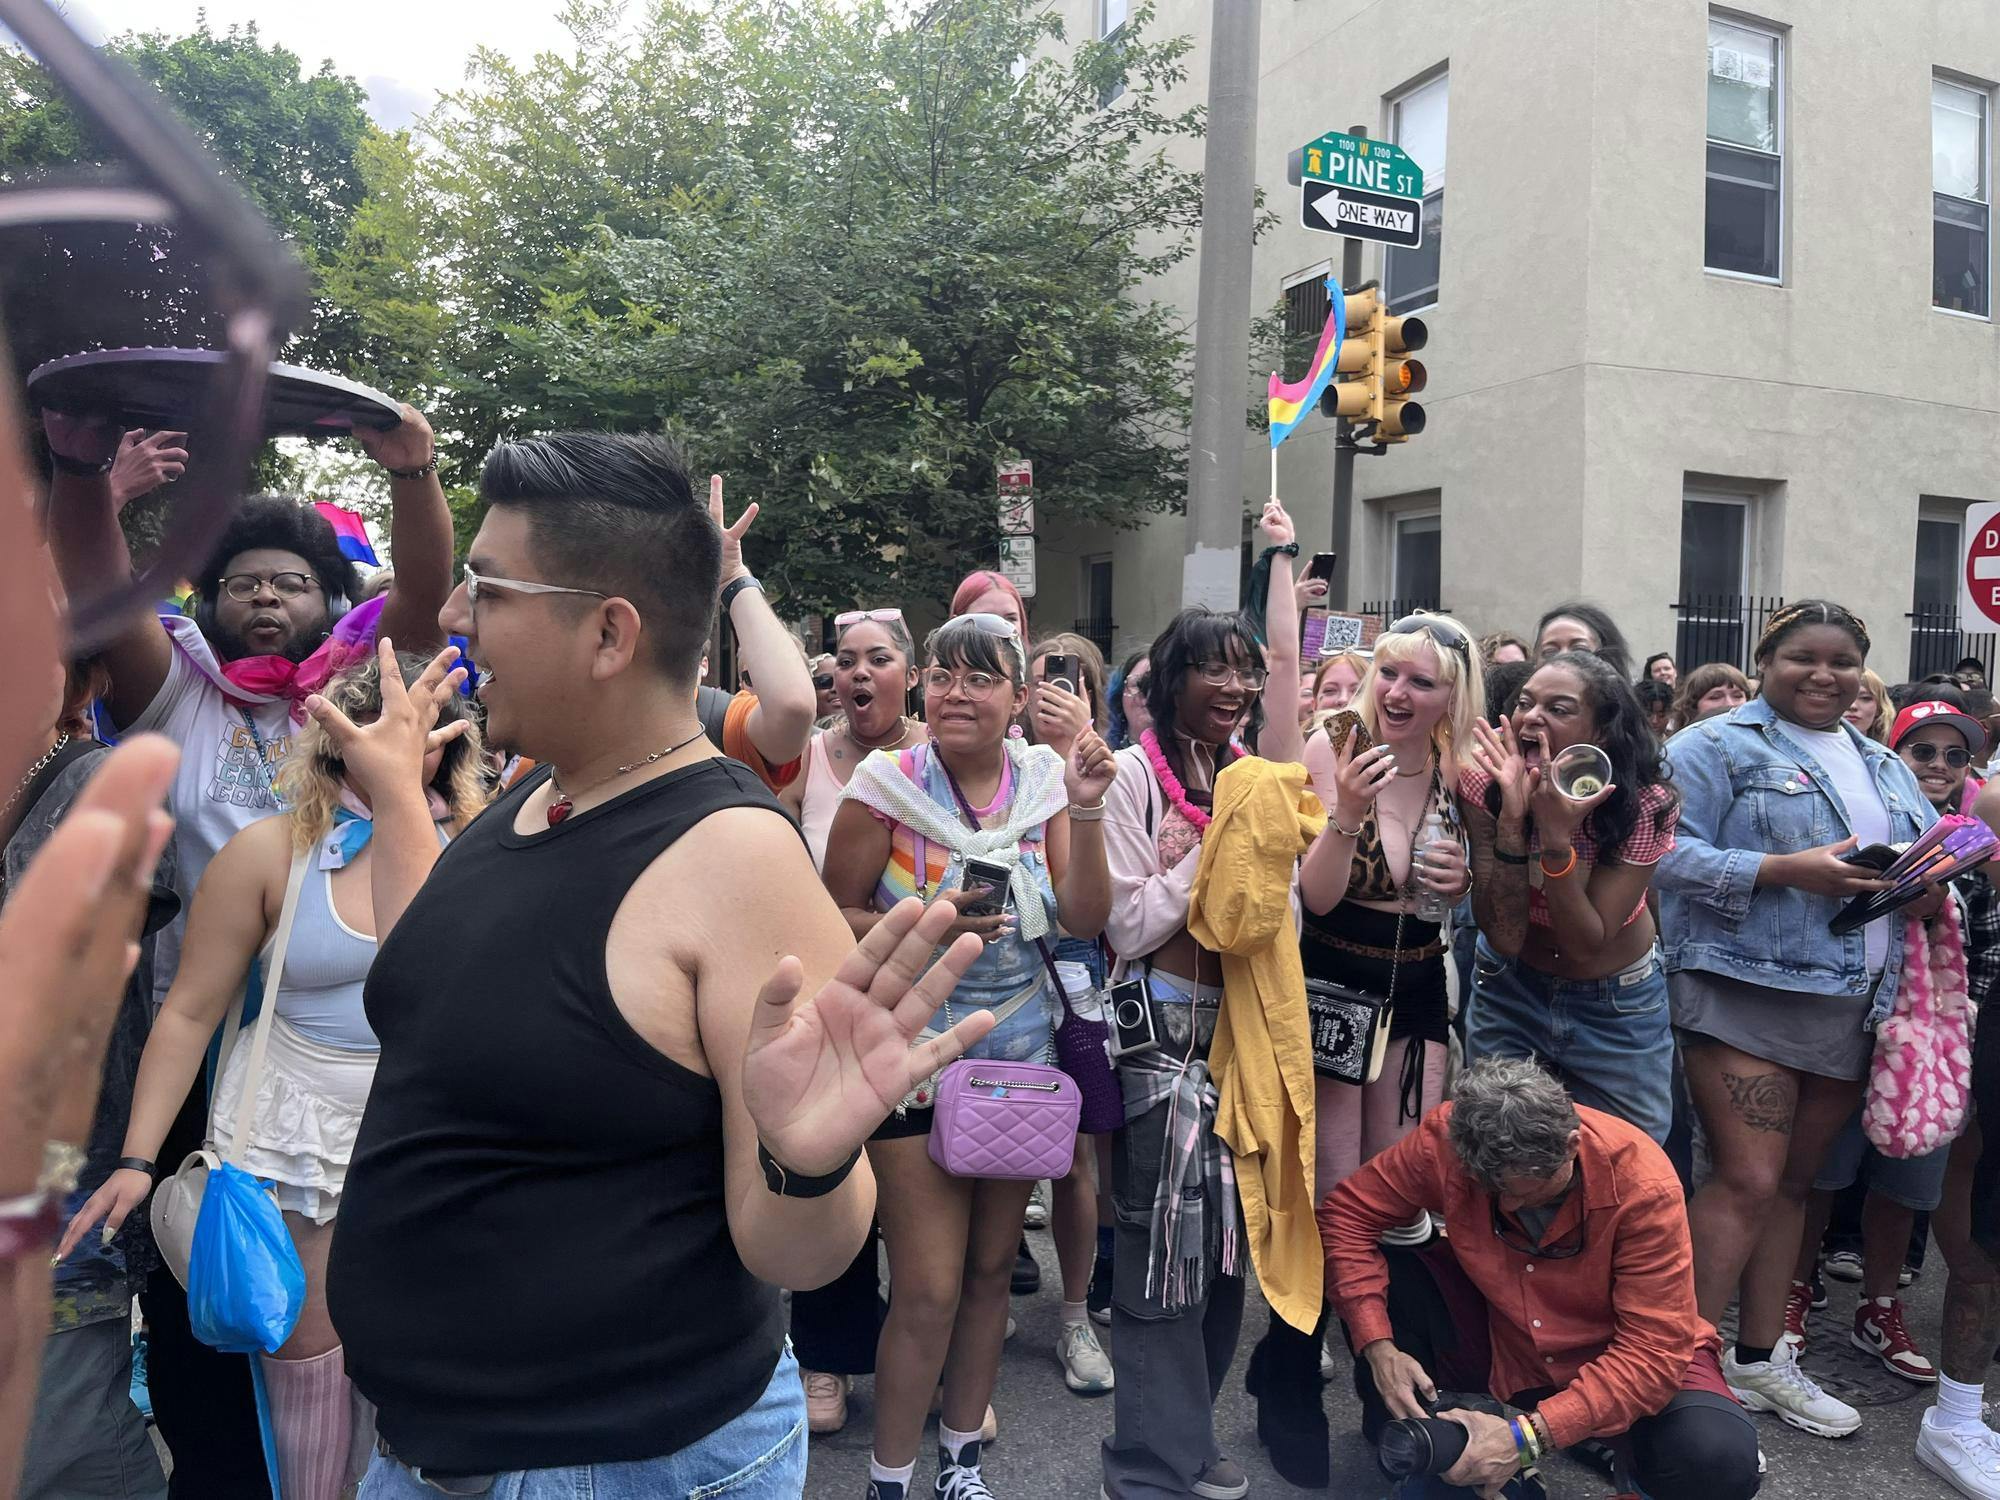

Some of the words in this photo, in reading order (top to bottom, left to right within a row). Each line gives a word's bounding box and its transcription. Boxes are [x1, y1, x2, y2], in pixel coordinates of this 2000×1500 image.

[1339, 139, 1355, 151] 1100
[1359, 142, 1369, 156] W
[1373, 147, 1391, 159] 1200
[1329, 152, 1390, 190] PINE
[1397, 174, 1413, 194] ST
[1338, 202, 1368, 223] ONE
[1374, 208, 1408, 230] WAY
[1985, 529, 1999, 549] D
